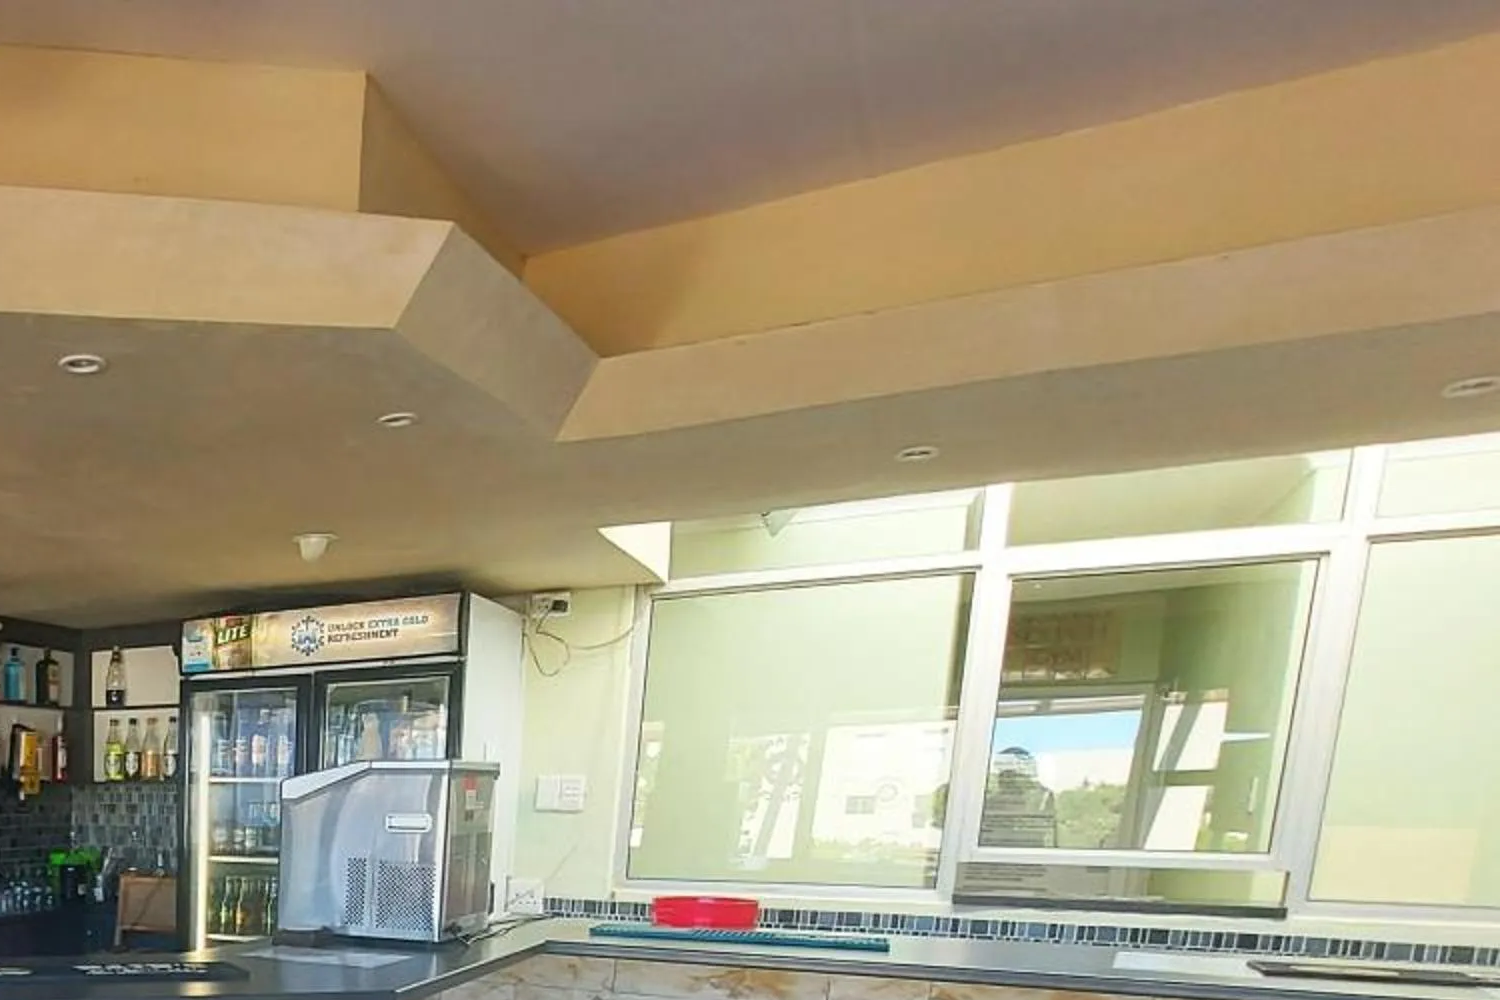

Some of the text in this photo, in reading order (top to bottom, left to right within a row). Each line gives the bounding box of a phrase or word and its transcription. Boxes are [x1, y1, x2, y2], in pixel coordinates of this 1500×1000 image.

[328, 615, 429, 633] UNLOCK EXTRA COLD
[217, 624, 250, 645] LITE
[328, 629, 399, 644] REFRESHMENT
